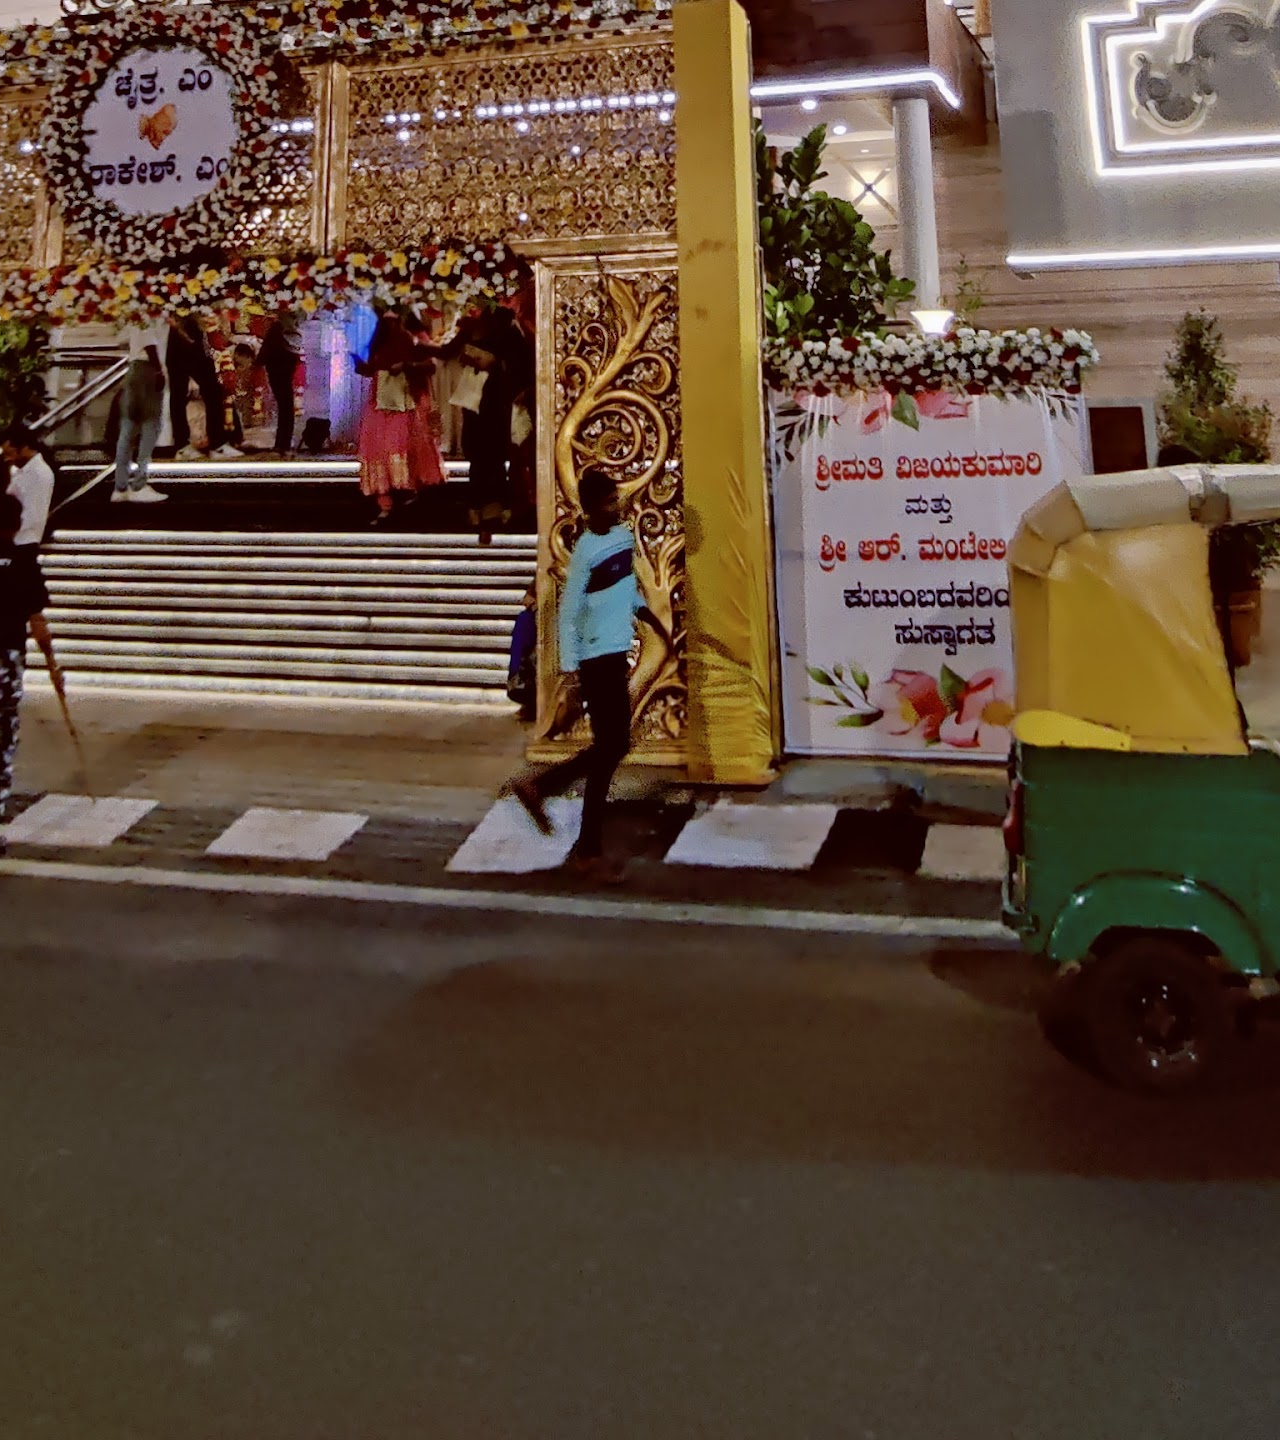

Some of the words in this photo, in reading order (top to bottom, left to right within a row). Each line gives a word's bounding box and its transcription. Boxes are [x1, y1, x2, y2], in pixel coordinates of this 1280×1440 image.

[815, 451, 884, 491] ಶ್ರೀಮತಿ
[895, 447, 1043, 480] ವಿಜಯಕುಮಾರಿ
[904, 493, 953, 524] ಮತ್ತು
[818, 533, 847, 572] ಶ್ರೀ
[843, 581, 1010, 609] ಕುಟುಂಬದವರಿಂ
[894, 616, 996, 656] ಸುಸ್ವಾಗತ
